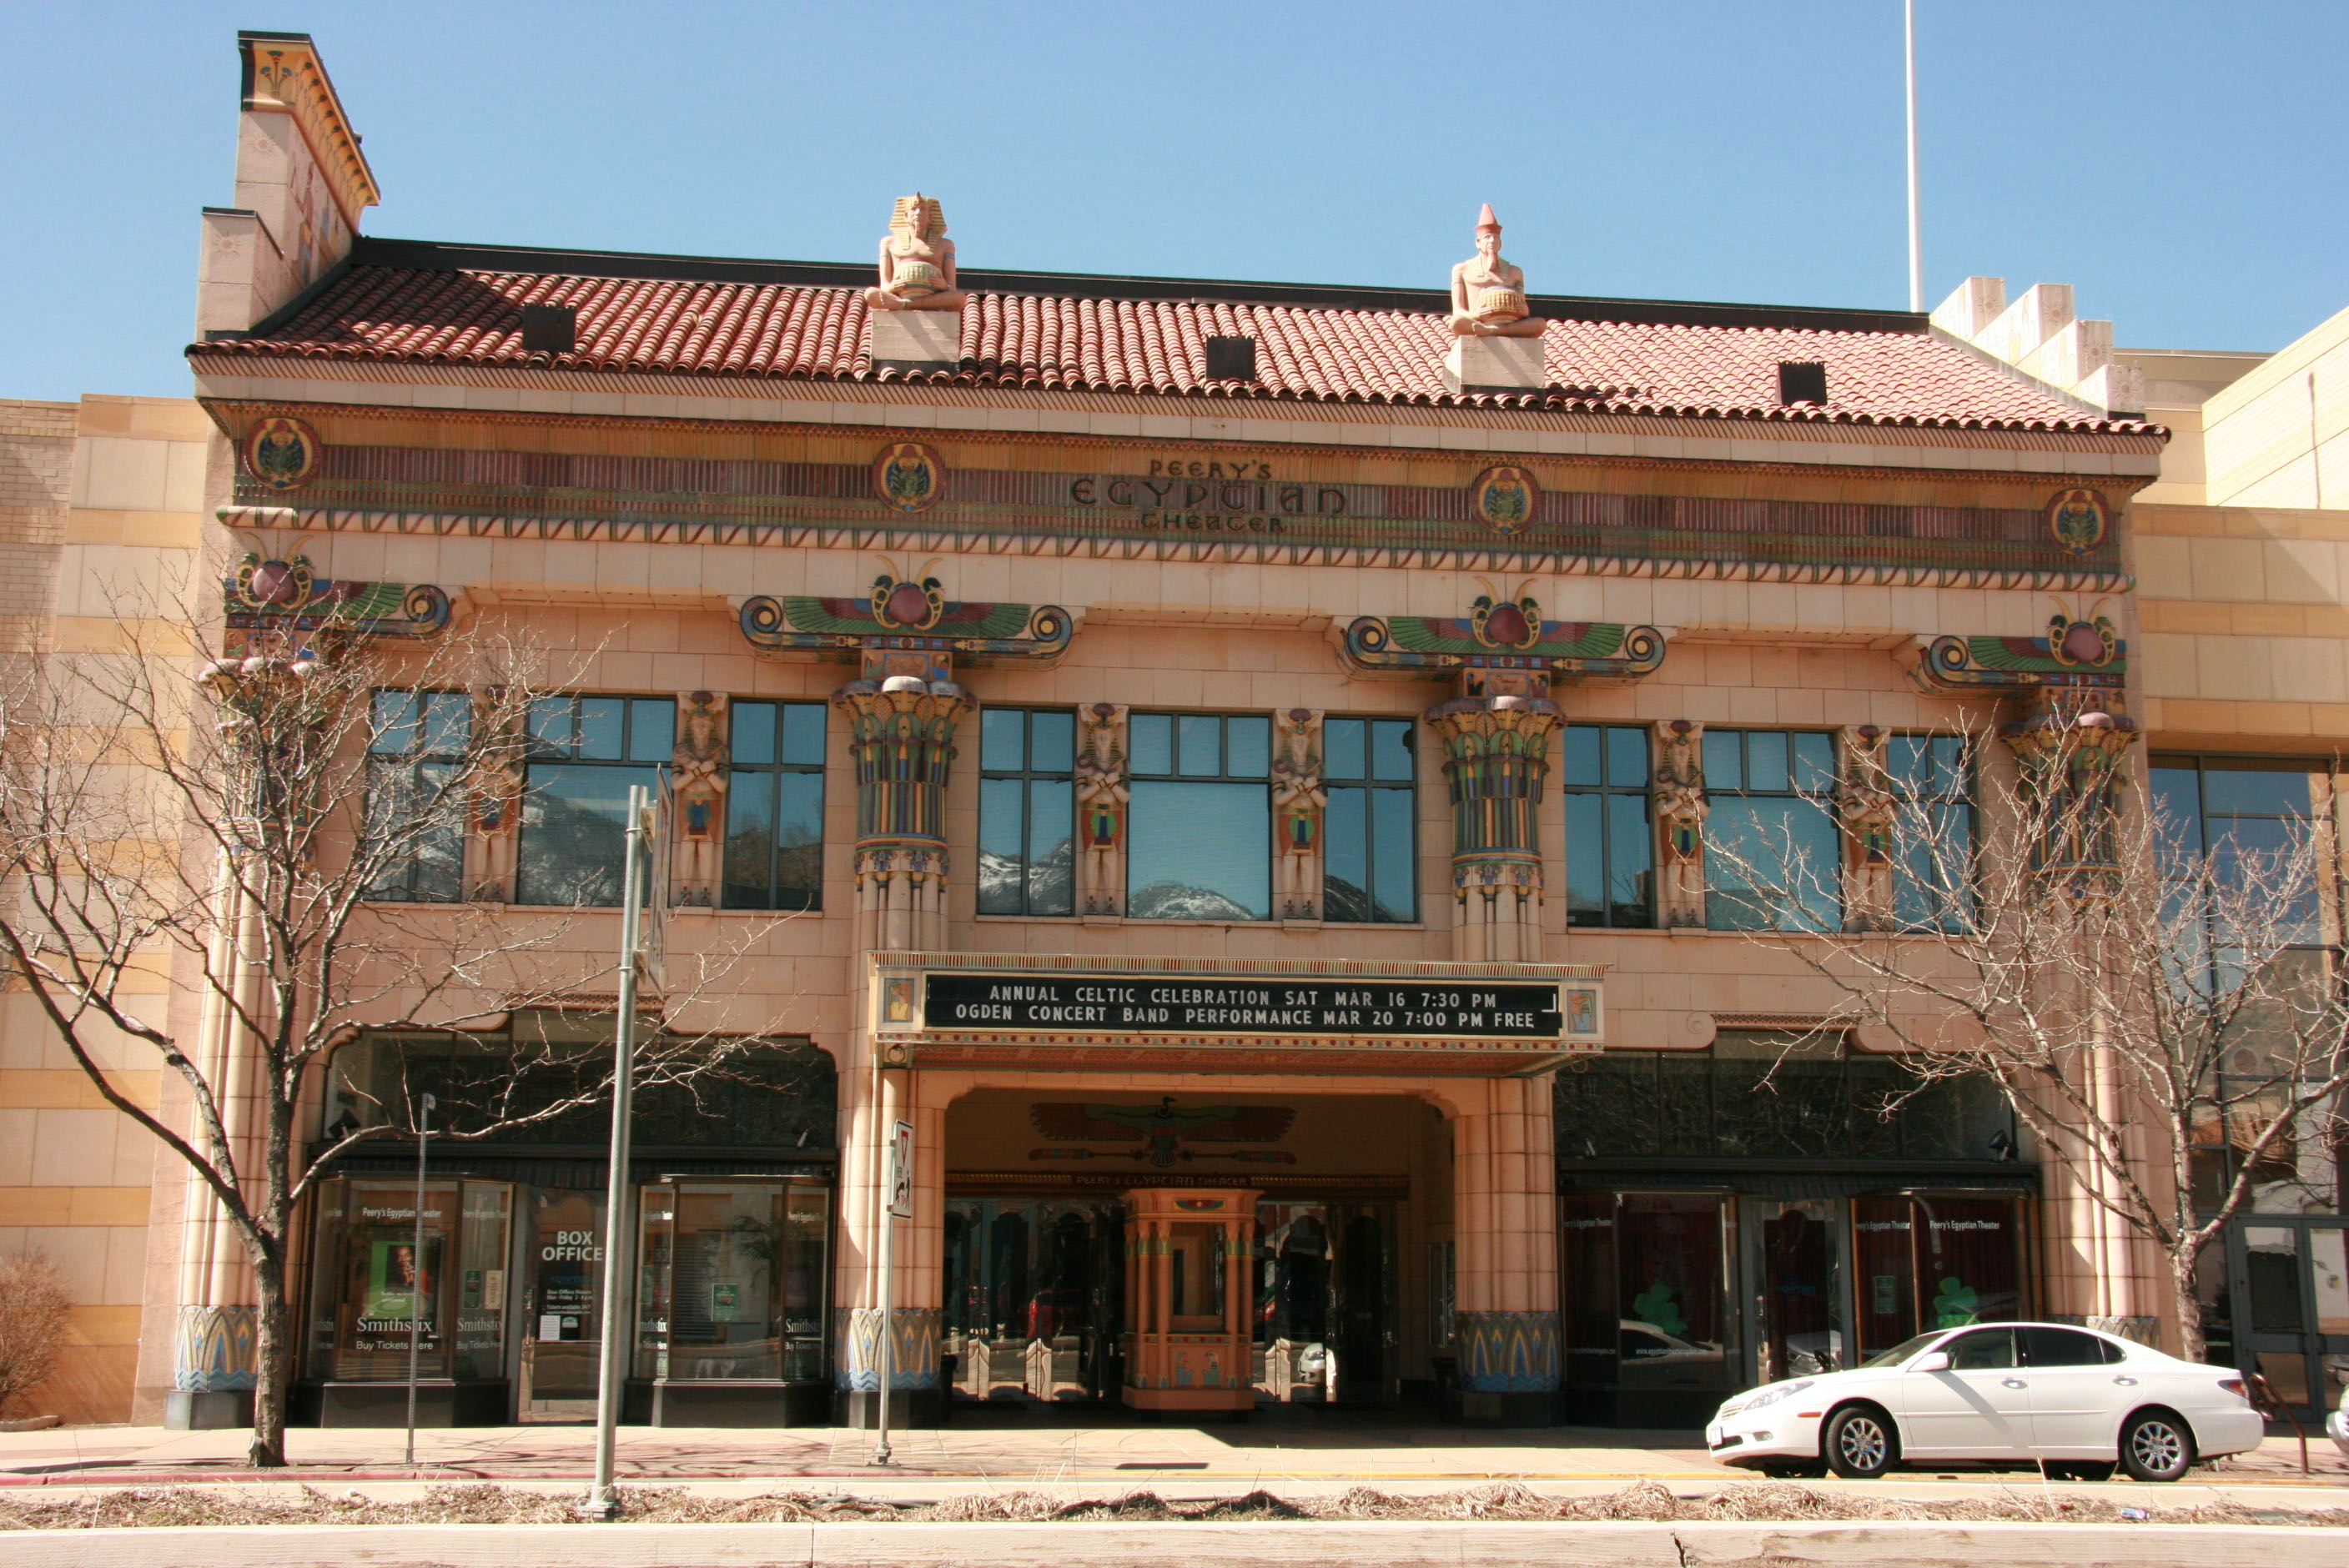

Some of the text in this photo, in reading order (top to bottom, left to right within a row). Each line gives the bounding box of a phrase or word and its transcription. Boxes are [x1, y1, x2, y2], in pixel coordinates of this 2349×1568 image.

[1149, 460, 1272, 479] PEERY'S
[1071, 479, 1346, 515] EGYPTIAN
[1140, 512, 1285, 533] THEATER
[989, 985, 1496, 1008] ANNUAL CELTIC CELEBRATION SAT MAR 16 7:30 PM
[955, 1004, 1534, 1028] OGDEN CONCERT BAND PERFORMANCE MAR 20 7:00 PM FREE
[362, 1207, 386, 1219] Peery's
[386, 1207, 416, 1219] Egyptian
[1929, 1219, 2001, 1232] Peery's Egyptian Theater
[557, 1230, 593, 1245] BOX
[542, 1247, 602, 1261] OFFICE
[357, 1317, 433, 1332] Smithsix
[356, 1340, 434, 1352] Buy Tickets ere
[457, 1340, 468, 1351] Buy
